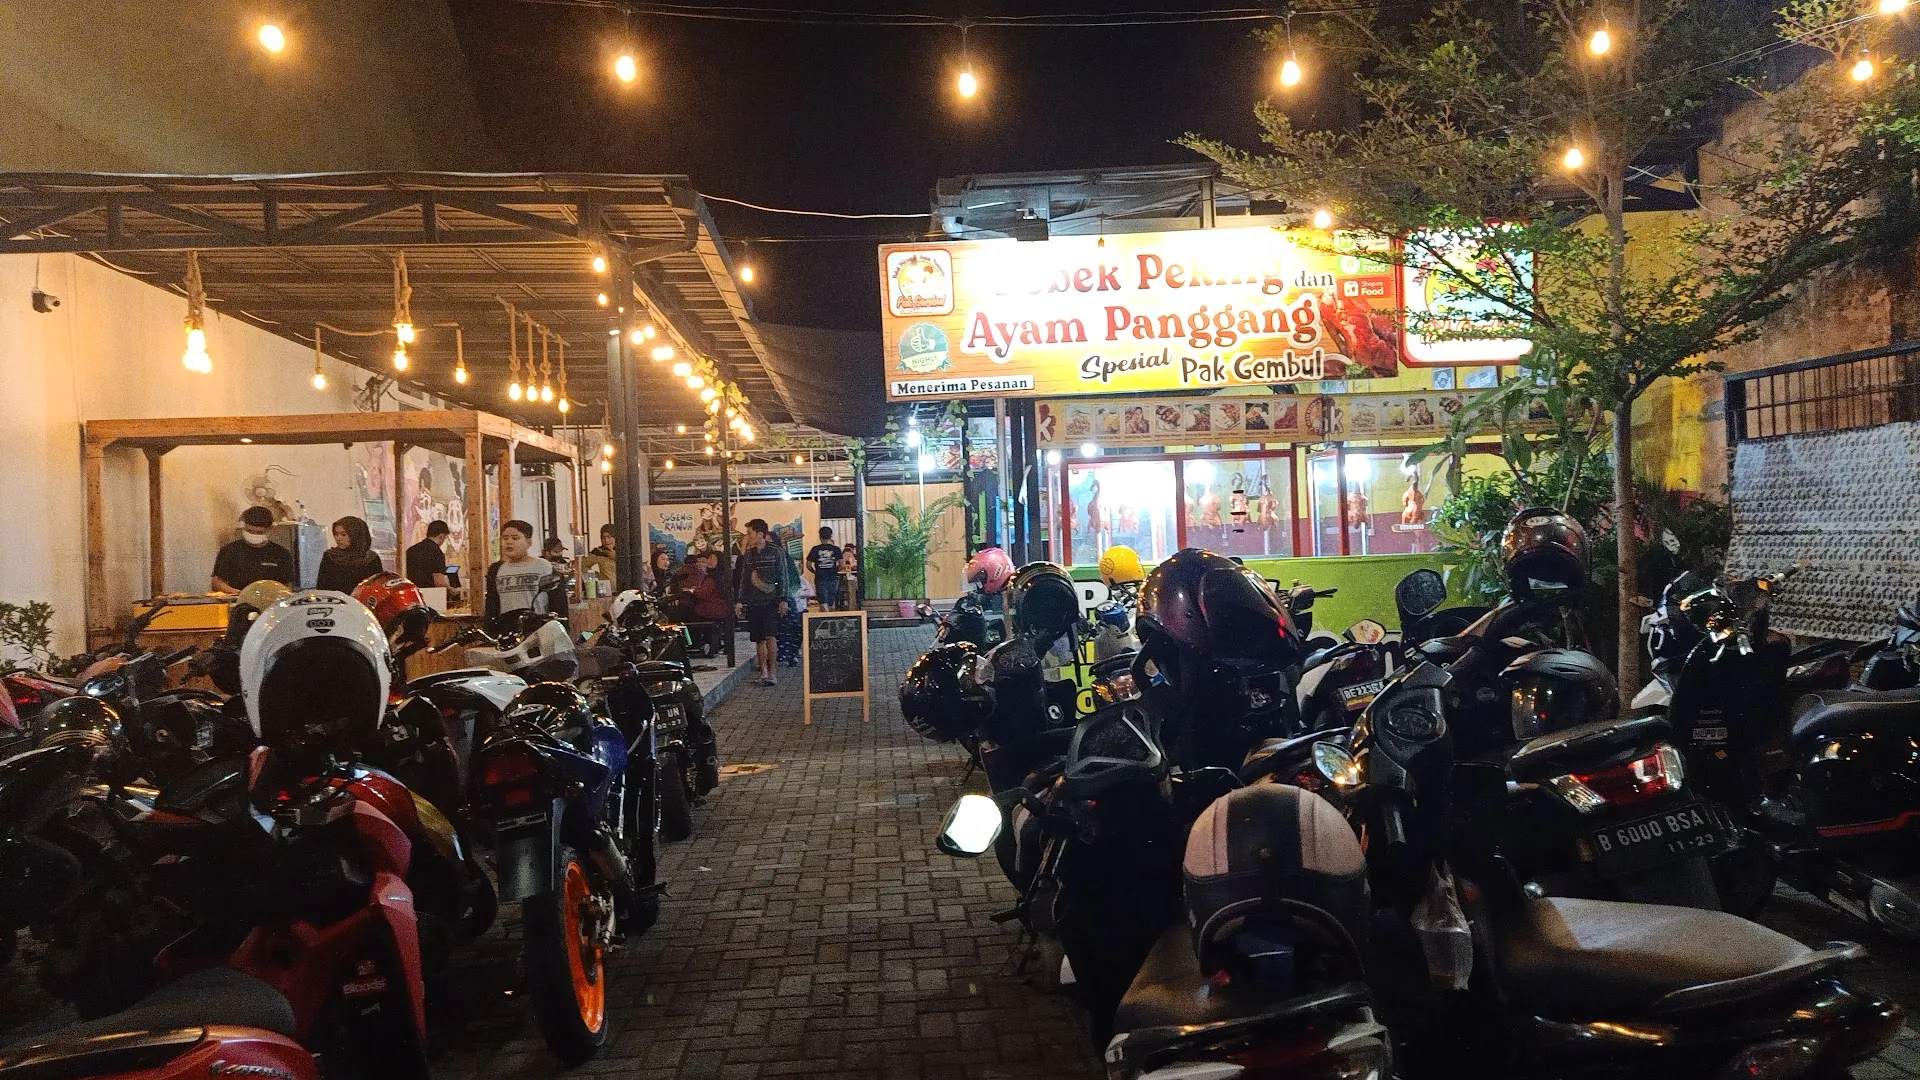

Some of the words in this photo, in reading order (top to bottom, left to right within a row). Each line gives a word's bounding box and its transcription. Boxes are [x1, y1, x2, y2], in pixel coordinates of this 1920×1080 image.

[1294, 270, 1335, 287] dan
[1361, 287, 1385, 296] Food
[967, 311, 1088, 358] Ayam
[1103, 299, 1318, 349] Panggang
[911, 355, 939, 365] HIGHLY
[1081, 348, 1172, 383] Spesial
[1181, 355, 1226, 383] Pak
[1233, 350, 1321, 380] Gembul
[897, 382, 967, 395] Menerima
[970, 379, 1028, 391] Pesanan
[1597, 834, 1612, 852] B
[1616, 820, 1663, 846] 6000
[1665, 809, 1705, 833] BSA
